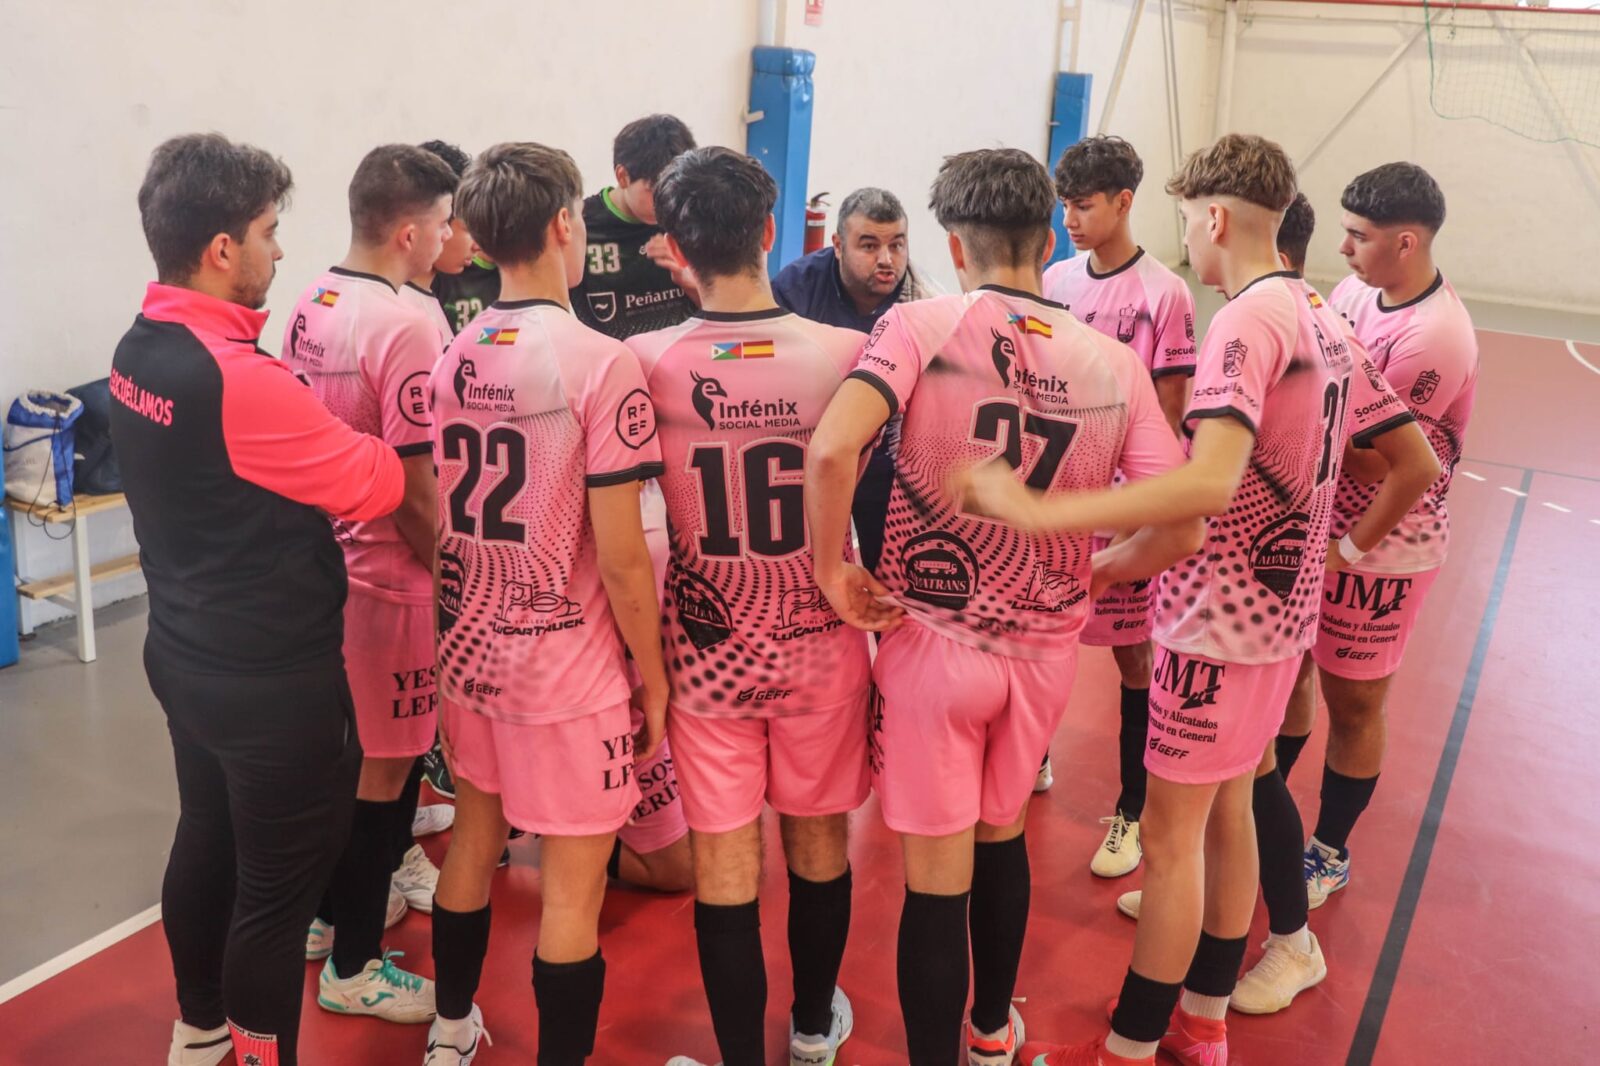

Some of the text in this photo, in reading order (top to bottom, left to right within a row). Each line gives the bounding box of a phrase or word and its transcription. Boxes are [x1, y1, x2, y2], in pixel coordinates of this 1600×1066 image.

[588, 242, 621, 275] 33
[468, 383, 515, 401] Infénix
[1036, 392, 1069, 405] MEDIA
[467, 402, 515, 412] SOCIAL MEDIA
[719, 398, 798, 419] Infénix
[719, 418, 801, 430] SOCIAL MEDIA
[968, 397, 1082, 491] 27
[440, 417, 529, 546] 22
[685, 436, 812, 560] 16
[1326, 570, 1413, 612] JMT
[1353, 622, 1360, 632] y
[1357, 635, 1368, 643] en
[1348, 650, 1379, 661] GEFF
[475, 683, 503, 697] GEFF
[754, 689, 793, 701] GEFF
[1163, 708, 1171, 720] y
[1169, 710, 1218, 730] Alicatados
[1166, 726, 1177, 736] en
[1178, 728, 1217, 743] General
[1157, 743, 1190, 759] GEFF
